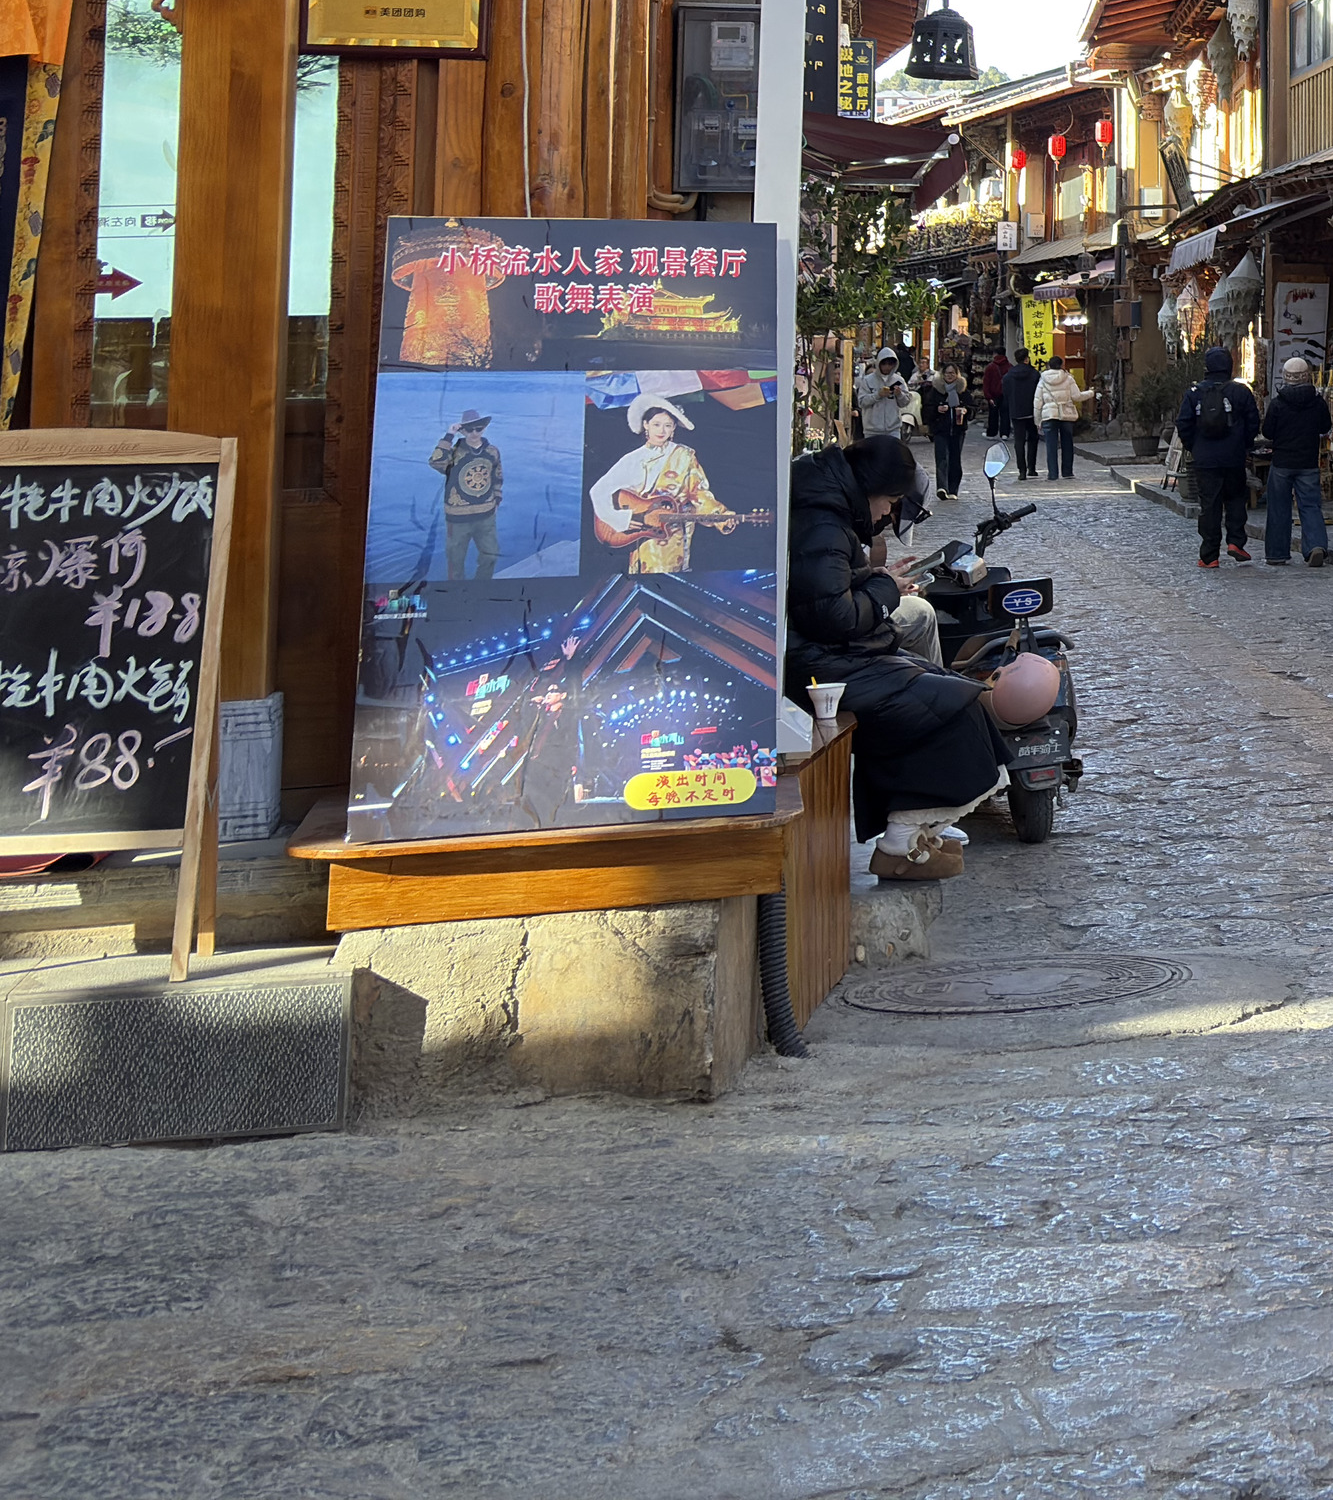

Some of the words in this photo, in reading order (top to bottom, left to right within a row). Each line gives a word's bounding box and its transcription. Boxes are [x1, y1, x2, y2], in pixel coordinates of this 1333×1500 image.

[437, 244, 623, 277] 小桥流水人家
[631, 247, 748, 278] 观景餐厅
[533, 281, 656, 315] 歌舞表演
[655, 771, 727, 789] 演出时间
[646, 787, 735, 807] 每晚不定时
